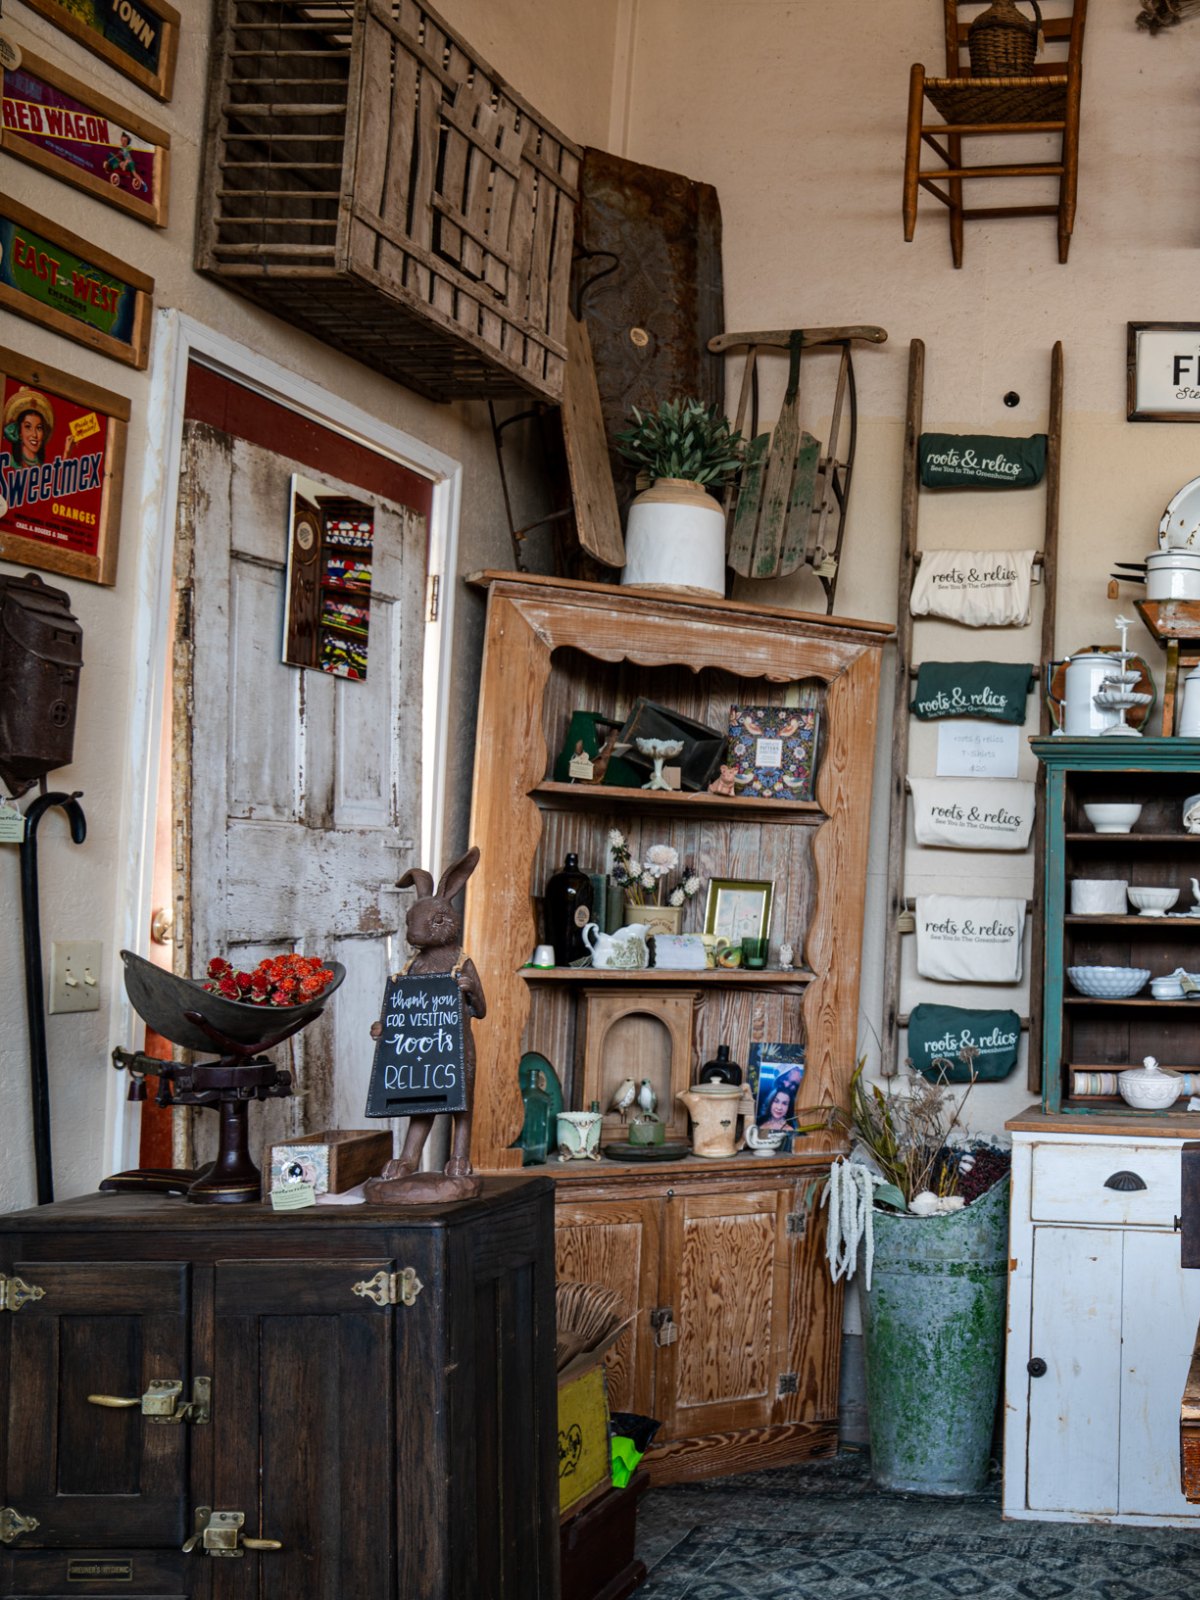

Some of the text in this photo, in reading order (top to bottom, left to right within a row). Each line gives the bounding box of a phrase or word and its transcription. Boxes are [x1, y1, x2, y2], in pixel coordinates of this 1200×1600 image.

[112, 0, 155, 49] TOWN
[3, 100, 110, 144] RED WAGON
[14, 236, 119, 314] EAST WEST
[926, 448, 1022, 475] roots & relics
[962, 467, 975, 475] The
[976, 469, 1017, 481] Greenhouse!
[52, 502, 96, 526] ORANGES
[932, 565, 1018, 584] roots & relics
[918, 686, 1008, 713] roots & relics
[931, 804, 1023, 827] roots & relics
[966, 821, 979, 829] The
[925, 918, 1016, 937] roots & relics
[390, 989, 457, 1012] thank you
[386, 1011, 458, 1027] FOR VISITING
[385, 1028, 453, 1055] roots
[924, 1027, 1018, 1053] roots & relics
[930, 1051, 943, 1059] See
[384, 1064, 456, 1090] RELICS
